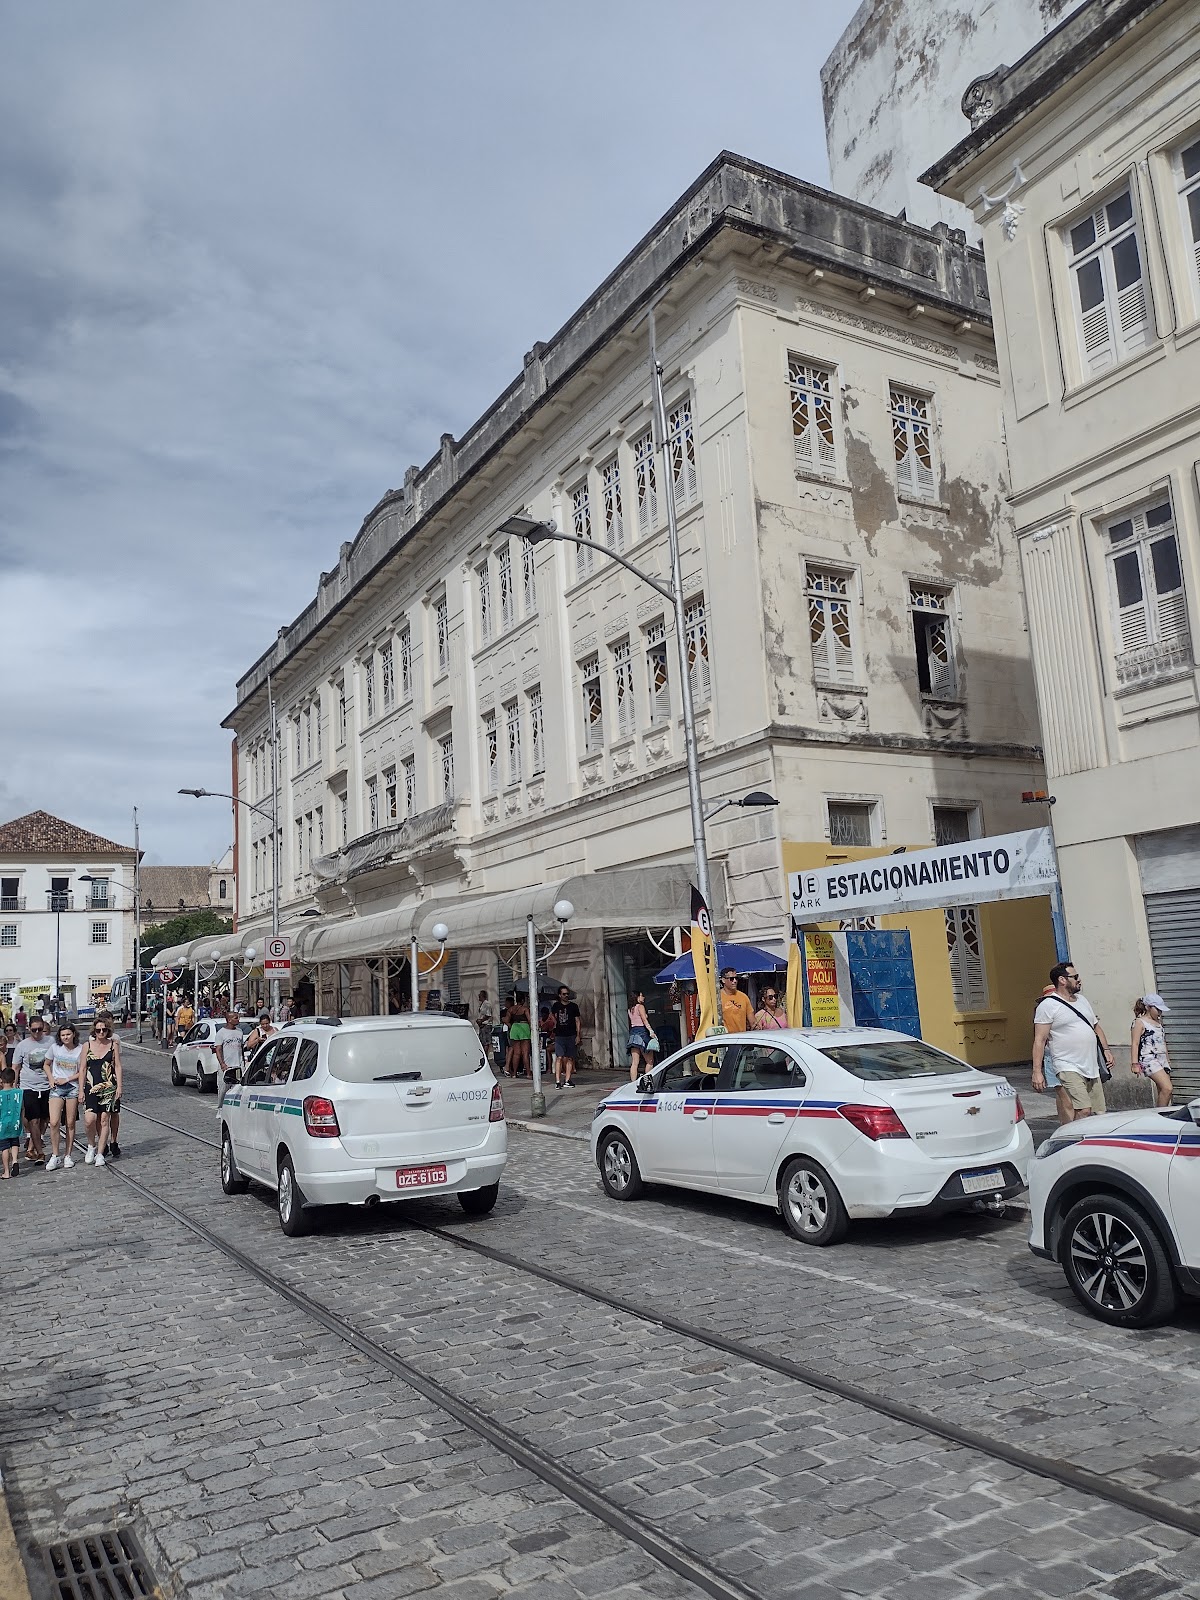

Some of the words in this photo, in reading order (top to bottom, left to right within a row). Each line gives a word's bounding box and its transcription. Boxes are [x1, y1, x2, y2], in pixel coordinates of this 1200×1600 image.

[827, 848, 1011, 900] ESTACIONAMENTO
[793, 899, 822, 910] PARK
[274, 943, 281, 954] E
[808, 960, 835, 969] ESTACIONE
[812, 971, 833, 984] AQUI
[816, 997, 835, 1005] JPARK
[817, 1015, 836, 1023] JPARK
[712, 1027, 726, 1036] TAXI
[447, 1089, 488, 1102] A-0092
